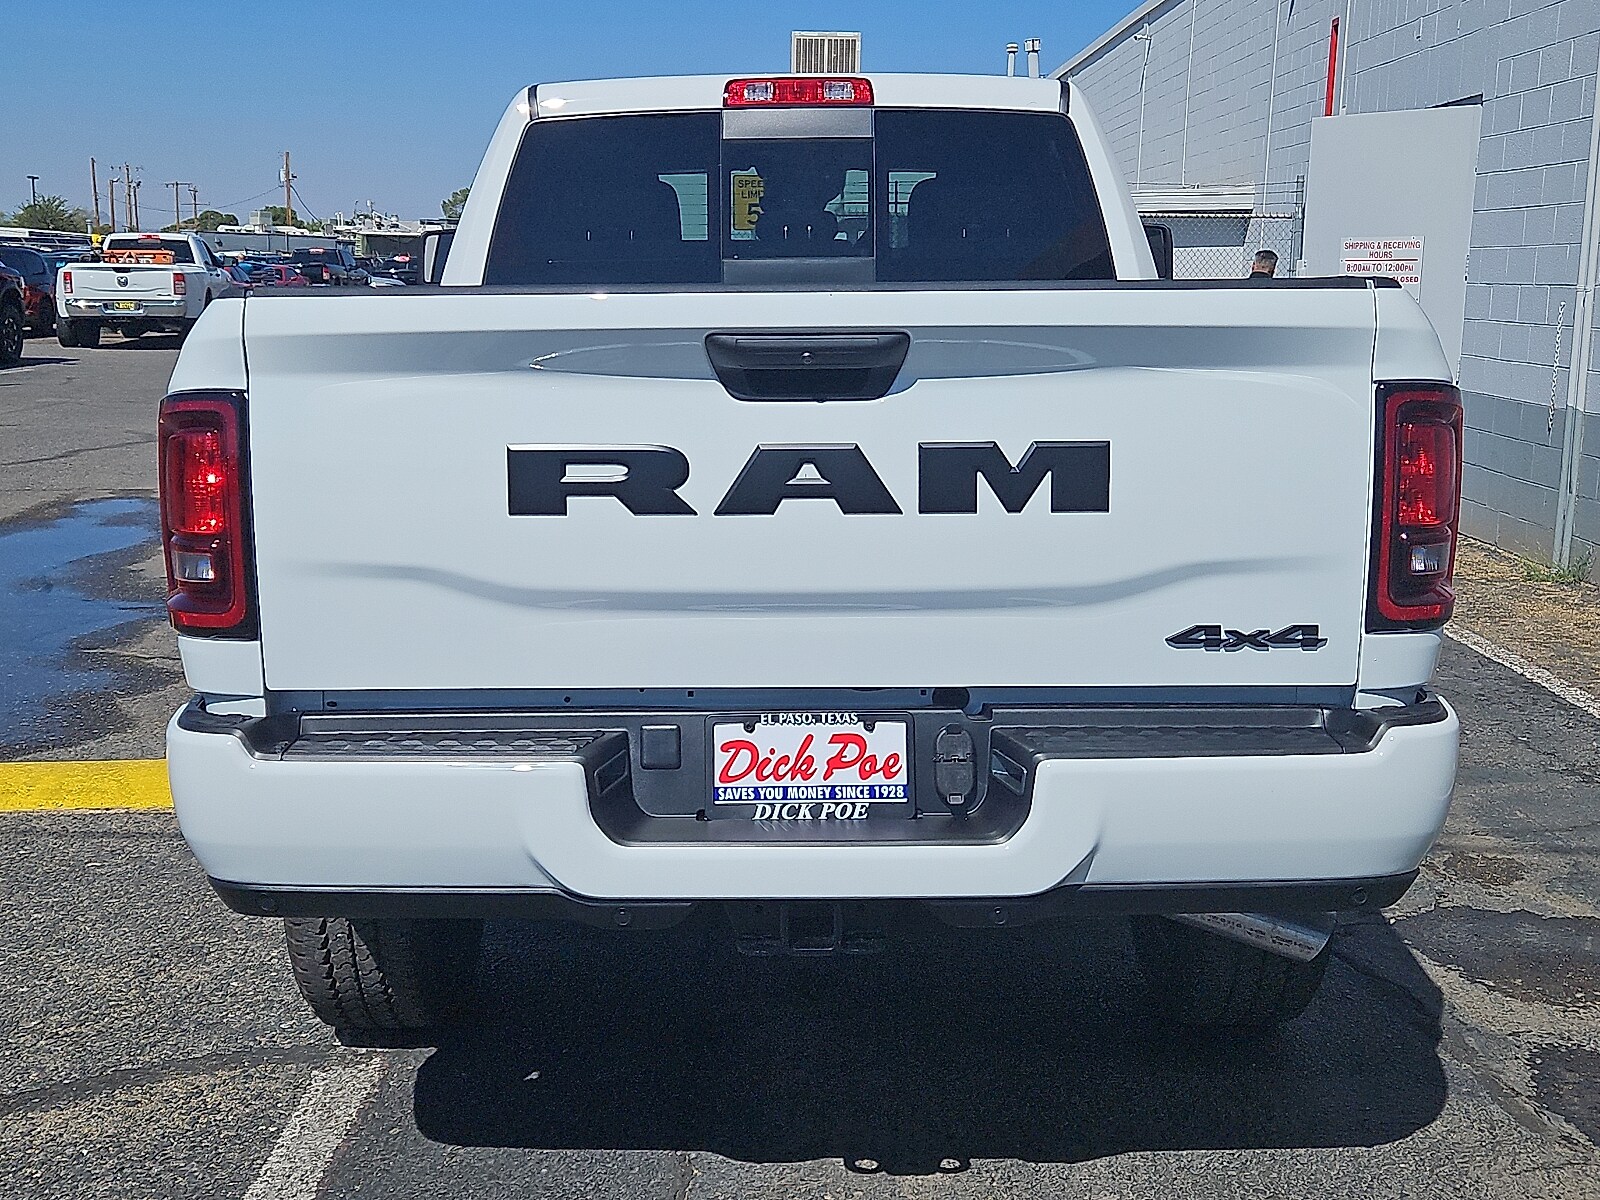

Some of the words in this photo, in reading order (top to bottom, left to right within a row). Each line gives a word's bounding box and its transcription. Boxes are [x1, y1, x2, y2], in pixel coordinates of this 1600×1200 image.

[738, 180, 764, 188] SPEE
[747, 203, 760, 225] 5
[1383, 241, 1421, 249] RECEIVING
[1346, 264, 1370, 272] 8:00AM
[1372, 263, 1382, 272] TO
[1385, 263, 1414, 272] 12:00PM
[506, 441, 1112, 517] RAM
[1165, 624, 1328, 652] 4x4
[761, 713, 775, 724] EL
[779, 713, 816, 725] PASO,
[820, 713, 858, 724] TEXAS
[718, 734, 817, 783] Dick
[823, 733, 902, 781] Poe
[718, 787, 755, 800] SAVES
[758, 787, 783, 799] YOU
[788, 787, 832, 799] MONEY
[835, 786, 870, 799] SINCE
[874, 786, 905, 798] 1928
[752, 803, 814, 820] DICK
[818, 802, 870, 820] POE
